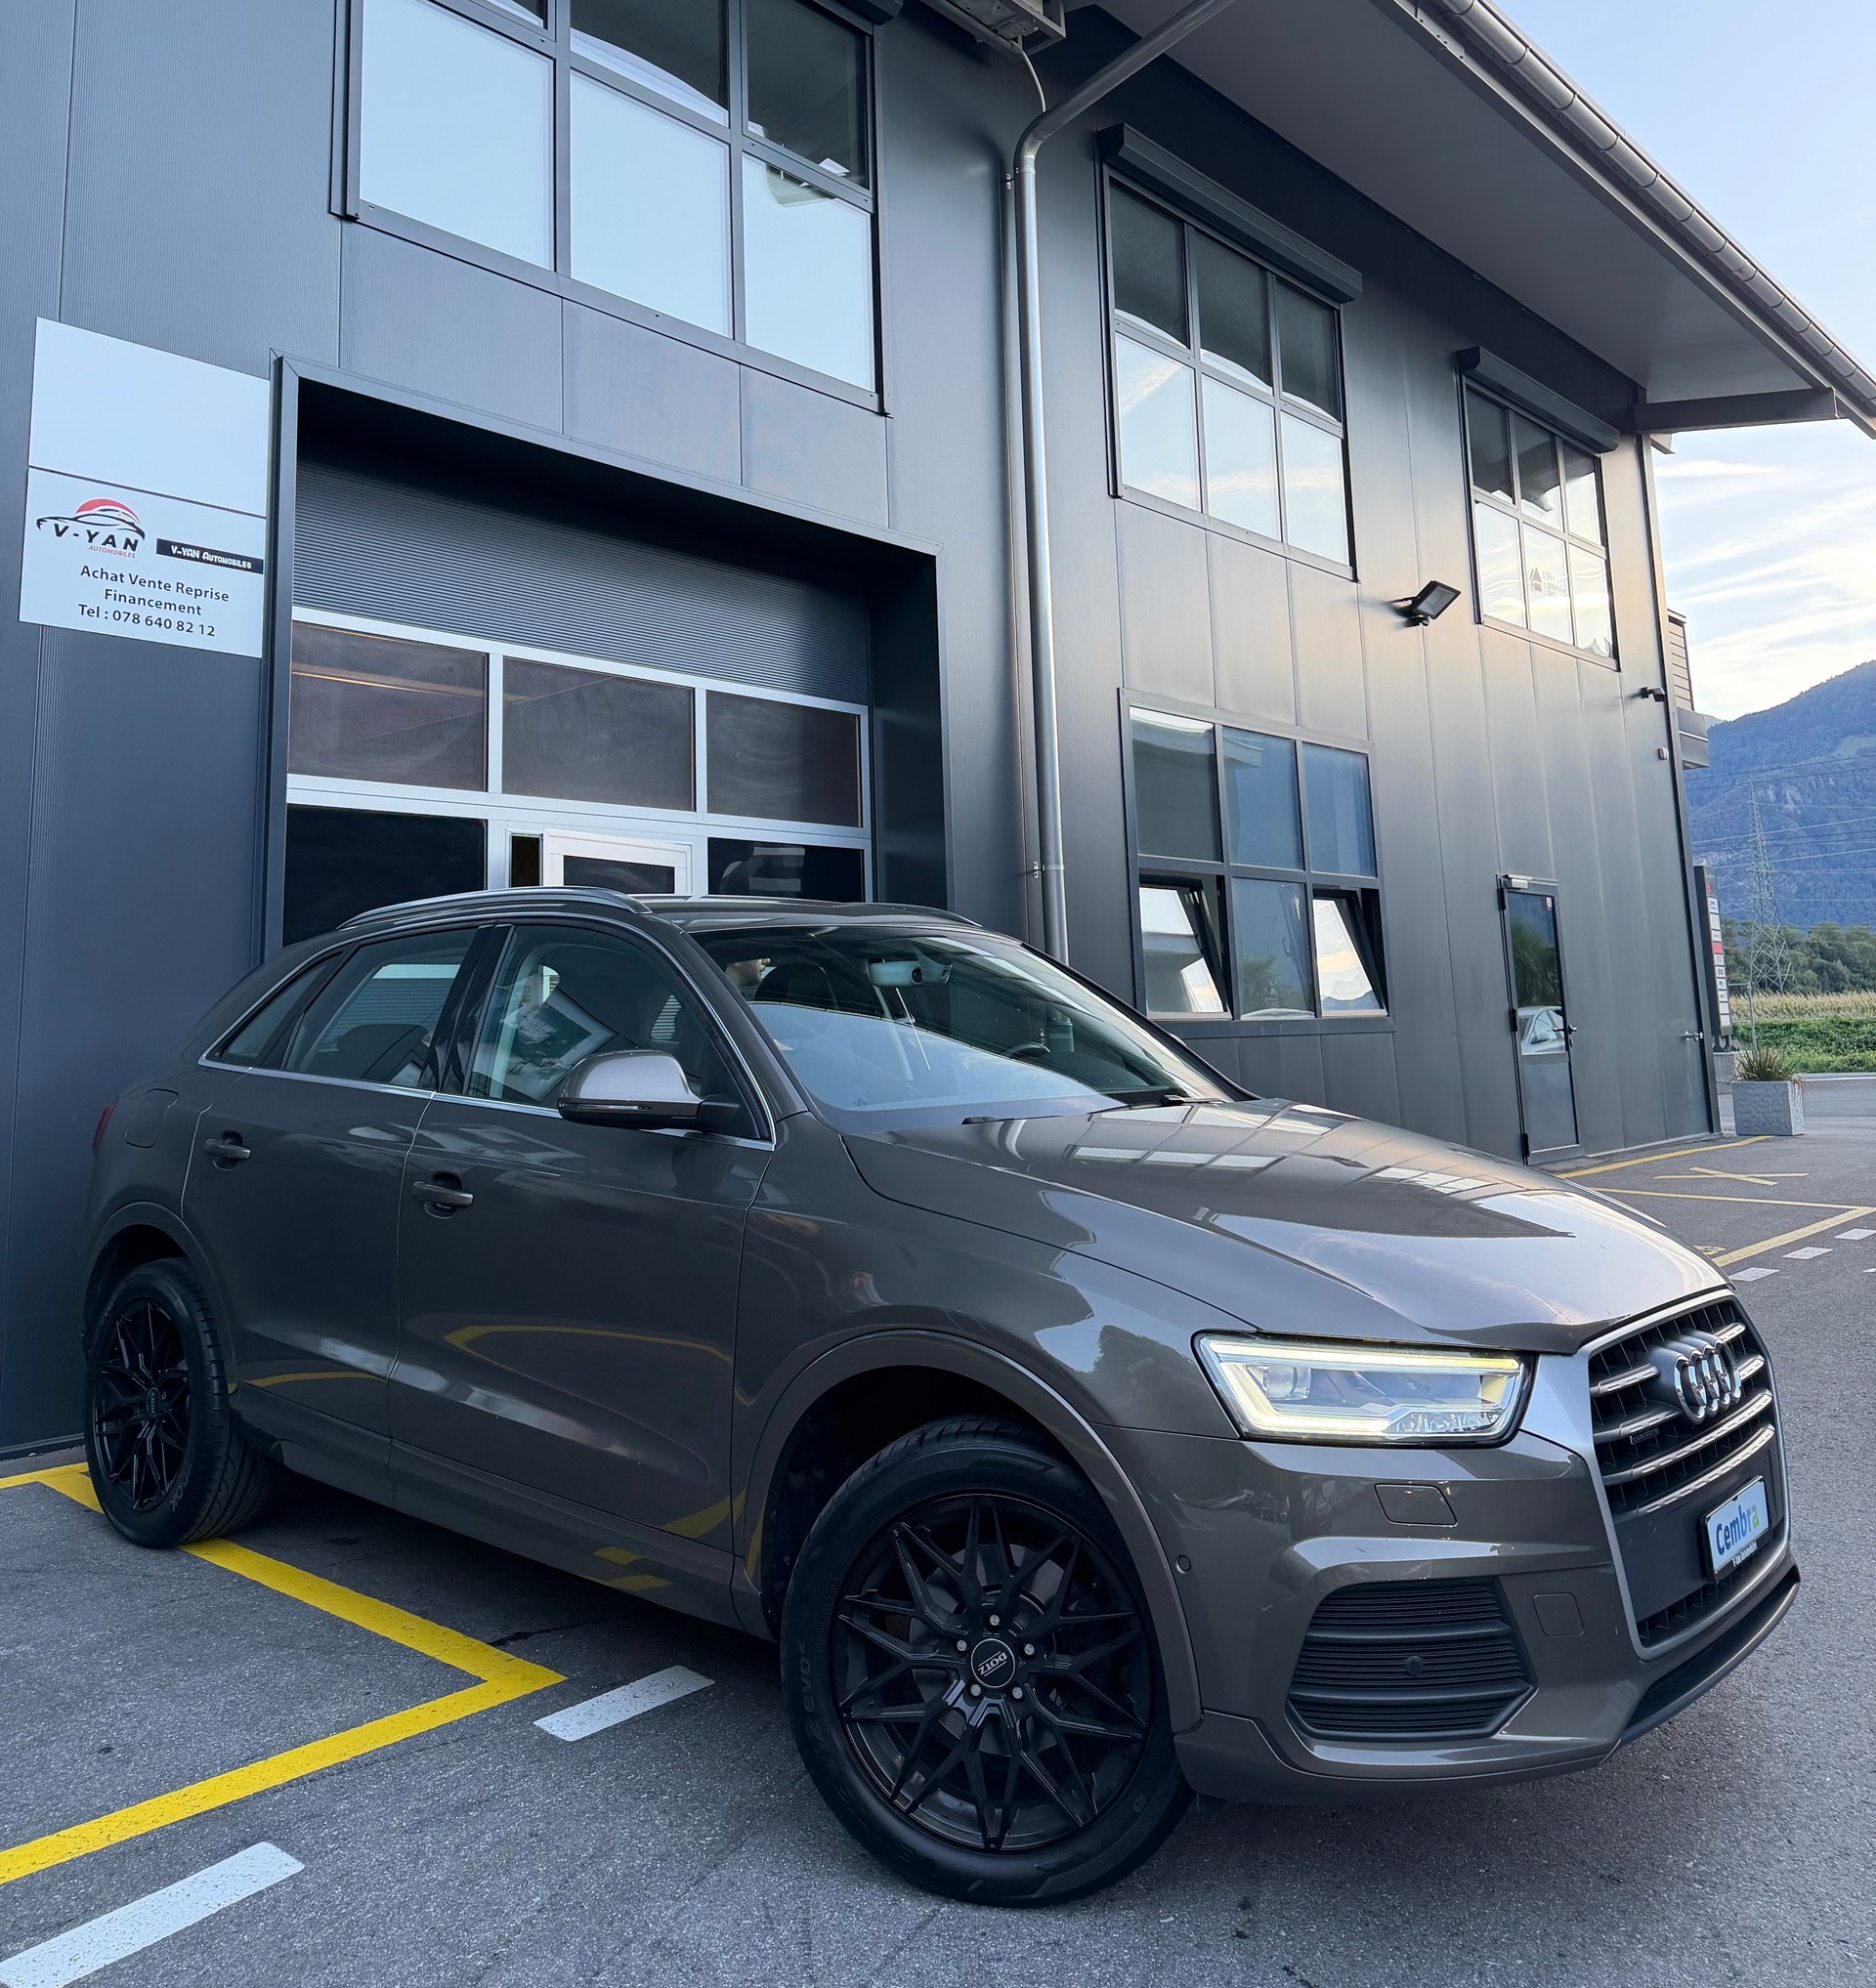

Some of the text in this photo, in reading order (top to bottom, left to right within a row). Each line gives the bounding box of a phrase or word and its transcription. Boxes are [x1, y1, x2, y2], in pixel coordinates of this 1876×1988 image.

[54, 523, 139, 552] V-YAN
[89, 545, 136, 559] AUTOMOBILES
[170, 544, 199, 560] V-YAN
[80, 565, 230, 602] Achat Vente Reprise
[105, 588, 201, 615] Financement
[112, 610, 141, 624] 078
[145, 615, 172, 629] 640
[176, 620, 193, 634] 82
[198, 624, 215, 637] 12
[1716, 1504, 1760, 1556] Cembra
[977, 1652, 1007, 1675] DOTZ
